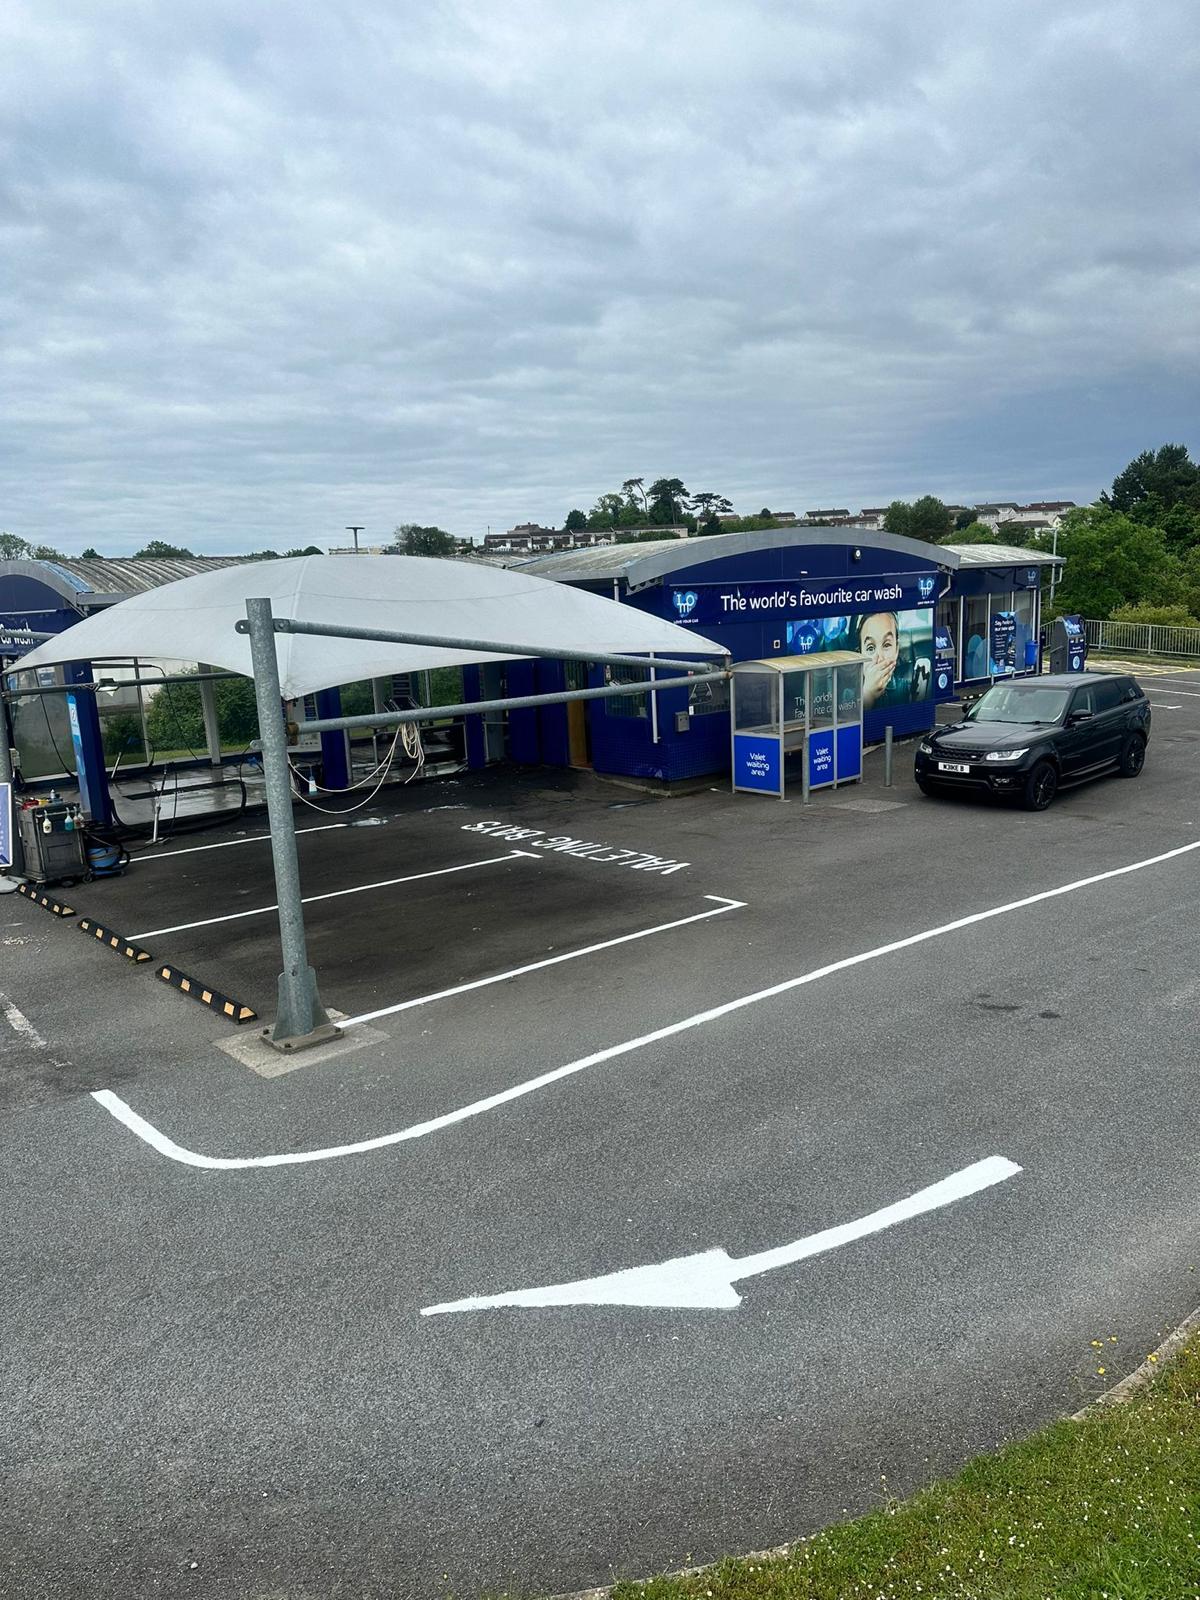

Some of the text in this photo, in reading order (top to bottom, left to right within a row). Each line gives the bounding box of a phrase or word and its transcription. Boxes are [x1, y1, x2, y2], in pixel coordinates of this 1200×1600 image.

[720, 584, 902, 612] The world's favourite car wash
[812, 691, 832, 704] orld's
[838, 700, 856, 711] wash
[750, 752, 766, 762] Valet
[815, 747, 829, 756] Valet
[813, 754, 831, 765] waiting
[746, 760, 770, 772] waiting
[816, 763, 828, 771] area
[751, 768, 765, 777] area
[460, 821, 691, 875] VALETING BAYS
